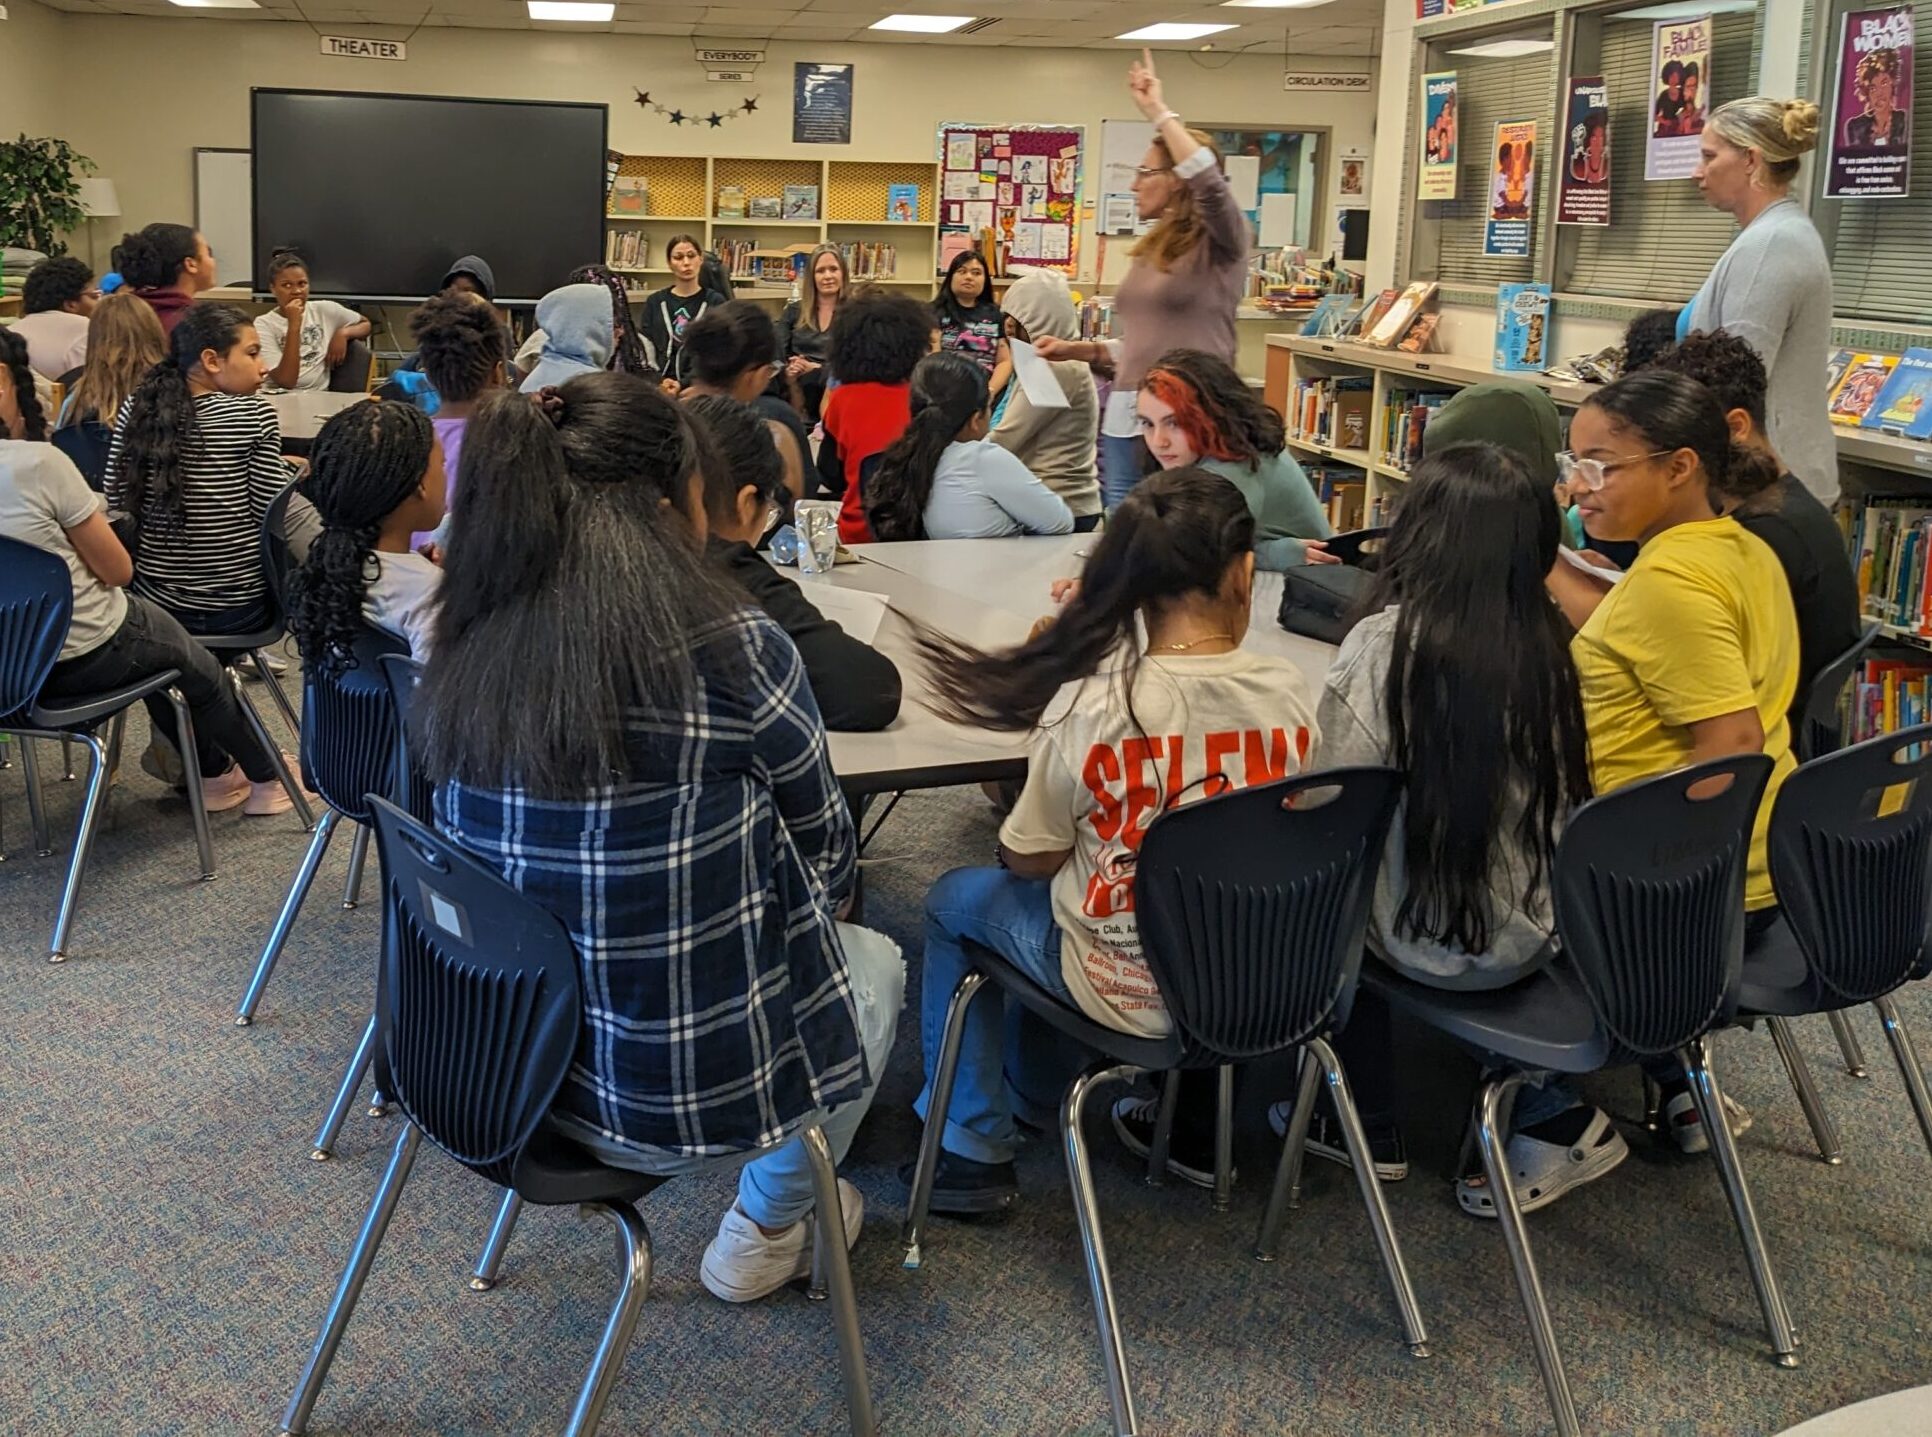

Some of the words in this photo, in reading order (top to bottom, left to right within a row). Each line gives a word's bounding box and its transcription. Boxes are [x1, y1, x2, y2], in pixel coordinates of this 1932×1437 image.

[329, 38, 398, 57] THEATER
[703, 51, 757, 61] EVERYBODY
[1287, 76, 1344, 86] CIRCULATION
[1346, 77, 1369, 86] DESK
[1082, 726, 1310, 850] SELEN
[1103, 924, 1123, 934] Club,
[1120, 1000, 1143, 1011] State
